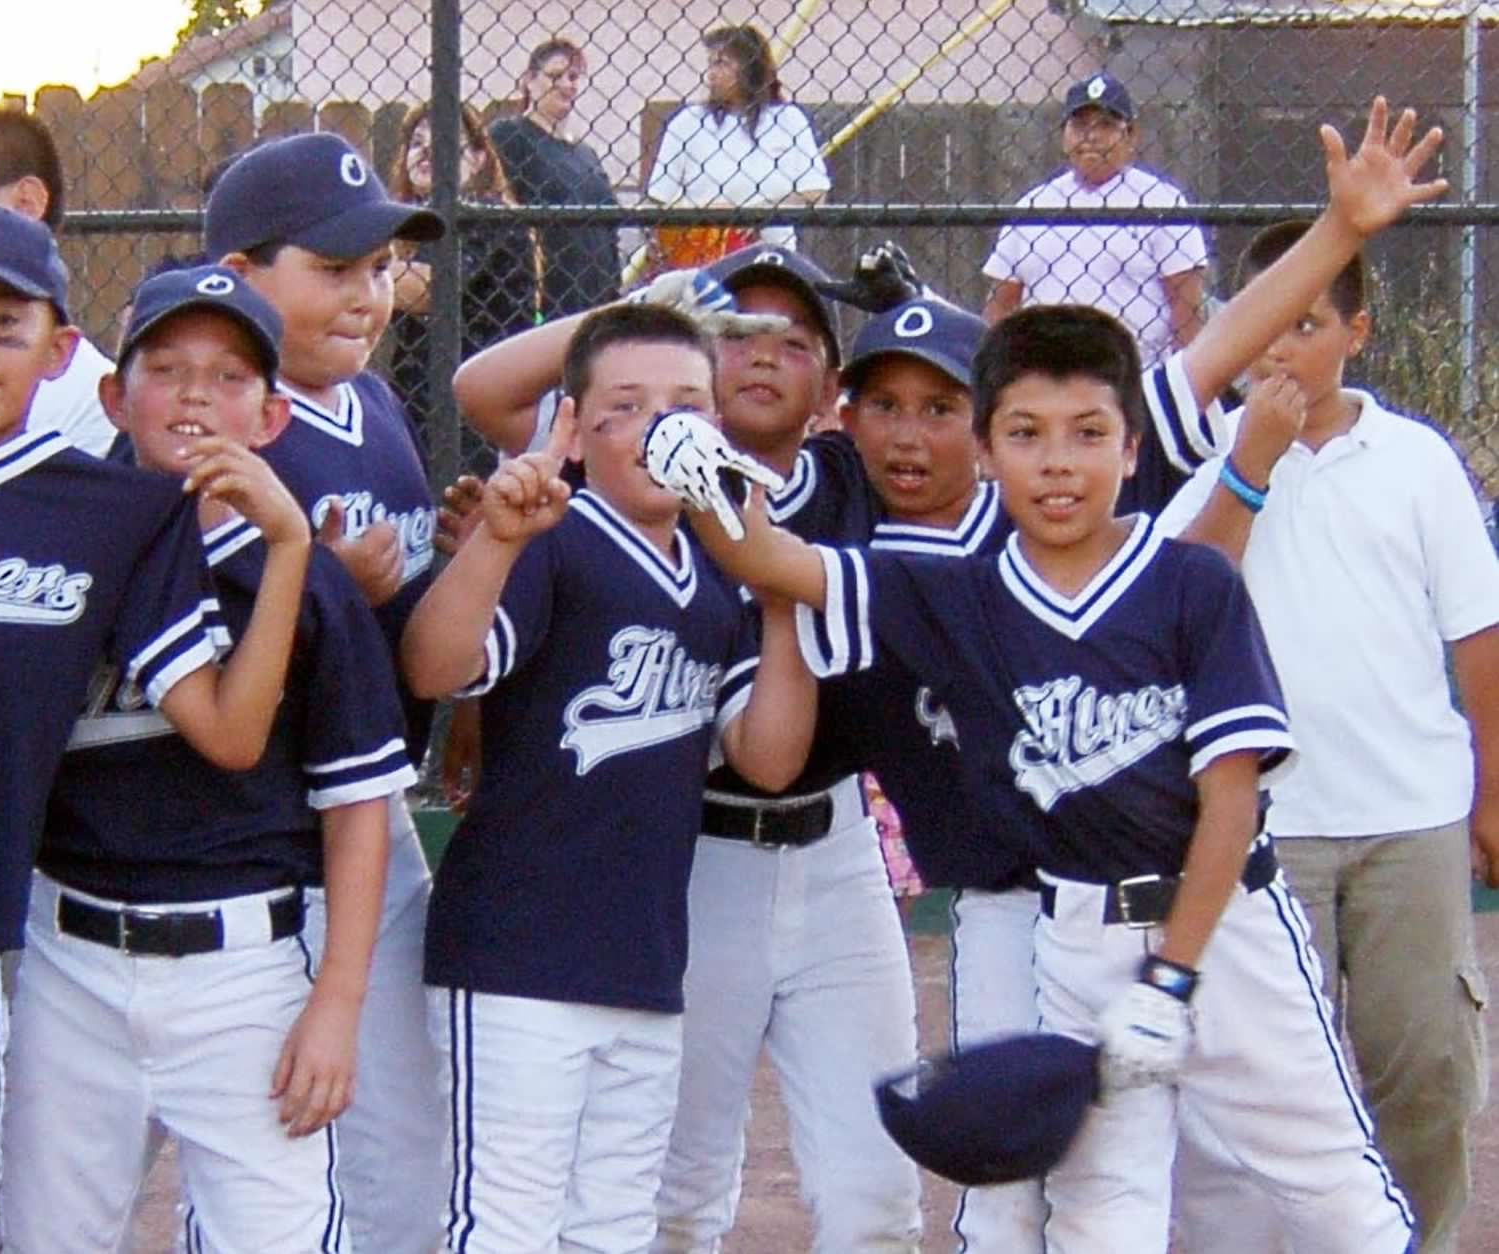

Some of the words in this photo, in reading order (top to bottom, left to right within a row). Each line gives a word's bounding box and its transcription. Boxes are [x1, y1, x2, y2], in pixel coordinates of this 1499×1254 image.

[341, 152, 367, 187] O
[196, 274, 235, 295] O
[894, 306, 933, 337] O
